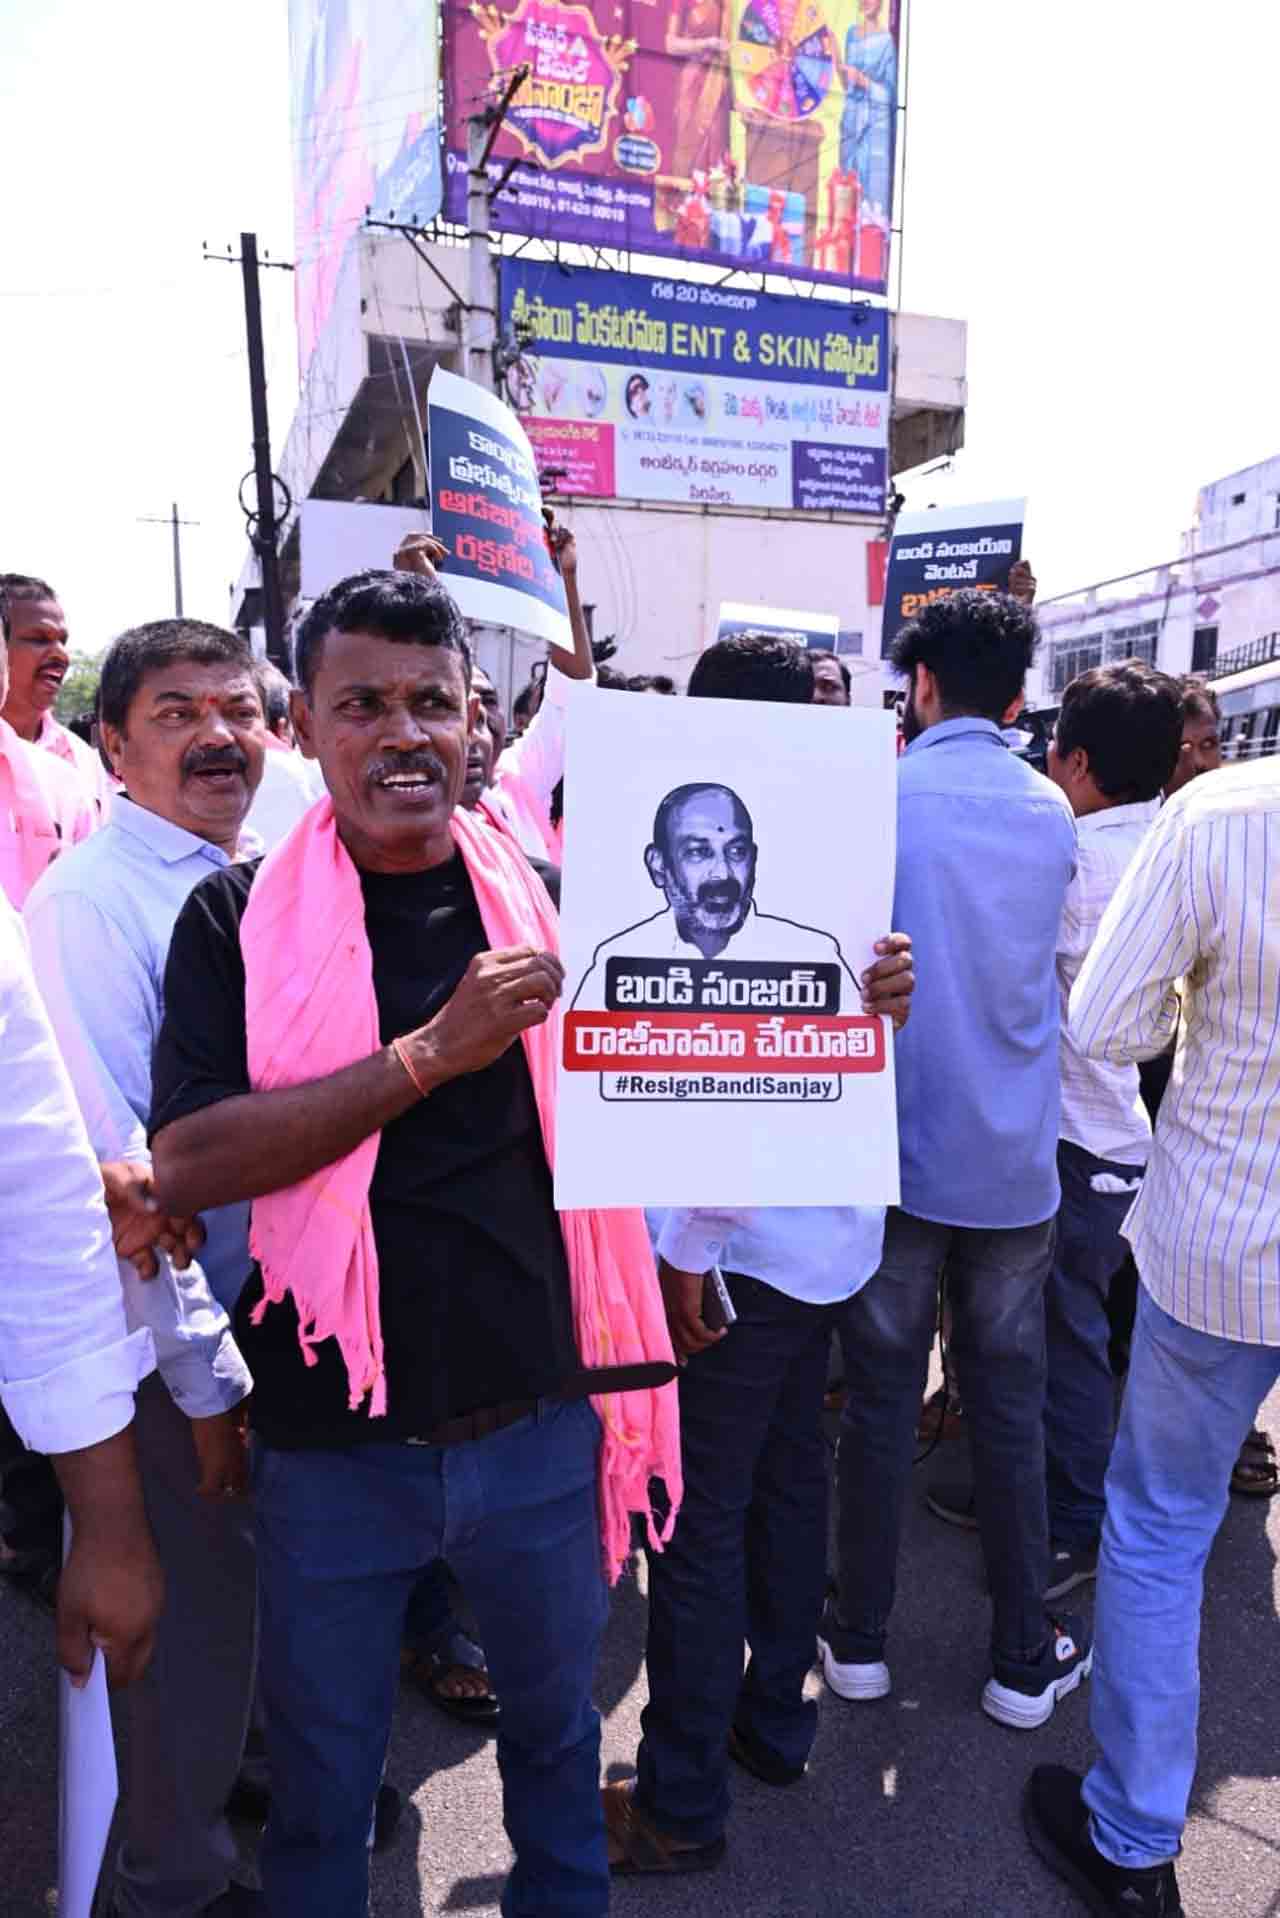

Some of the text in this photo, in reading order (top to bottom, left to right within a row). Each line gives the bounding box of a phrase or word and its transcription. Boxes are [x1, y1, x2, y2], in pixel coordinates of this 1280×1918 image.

[676, 285, 699, 303] 20
[671, 322, 725, 360] ENT
[734, 330, 752, 363] &
[759, 333, 821, 370] SKIN
[896, 543, 933, 560] బండి
[924, 559, 979, 580] వెంటనే
[616, 967, 827, 1007] బండి సంజయ్
[575, 1017, 875, 1057] రాజీనామా చేయాలి
[616, 1076, 832, 1098] #ResignBandiSanjay
